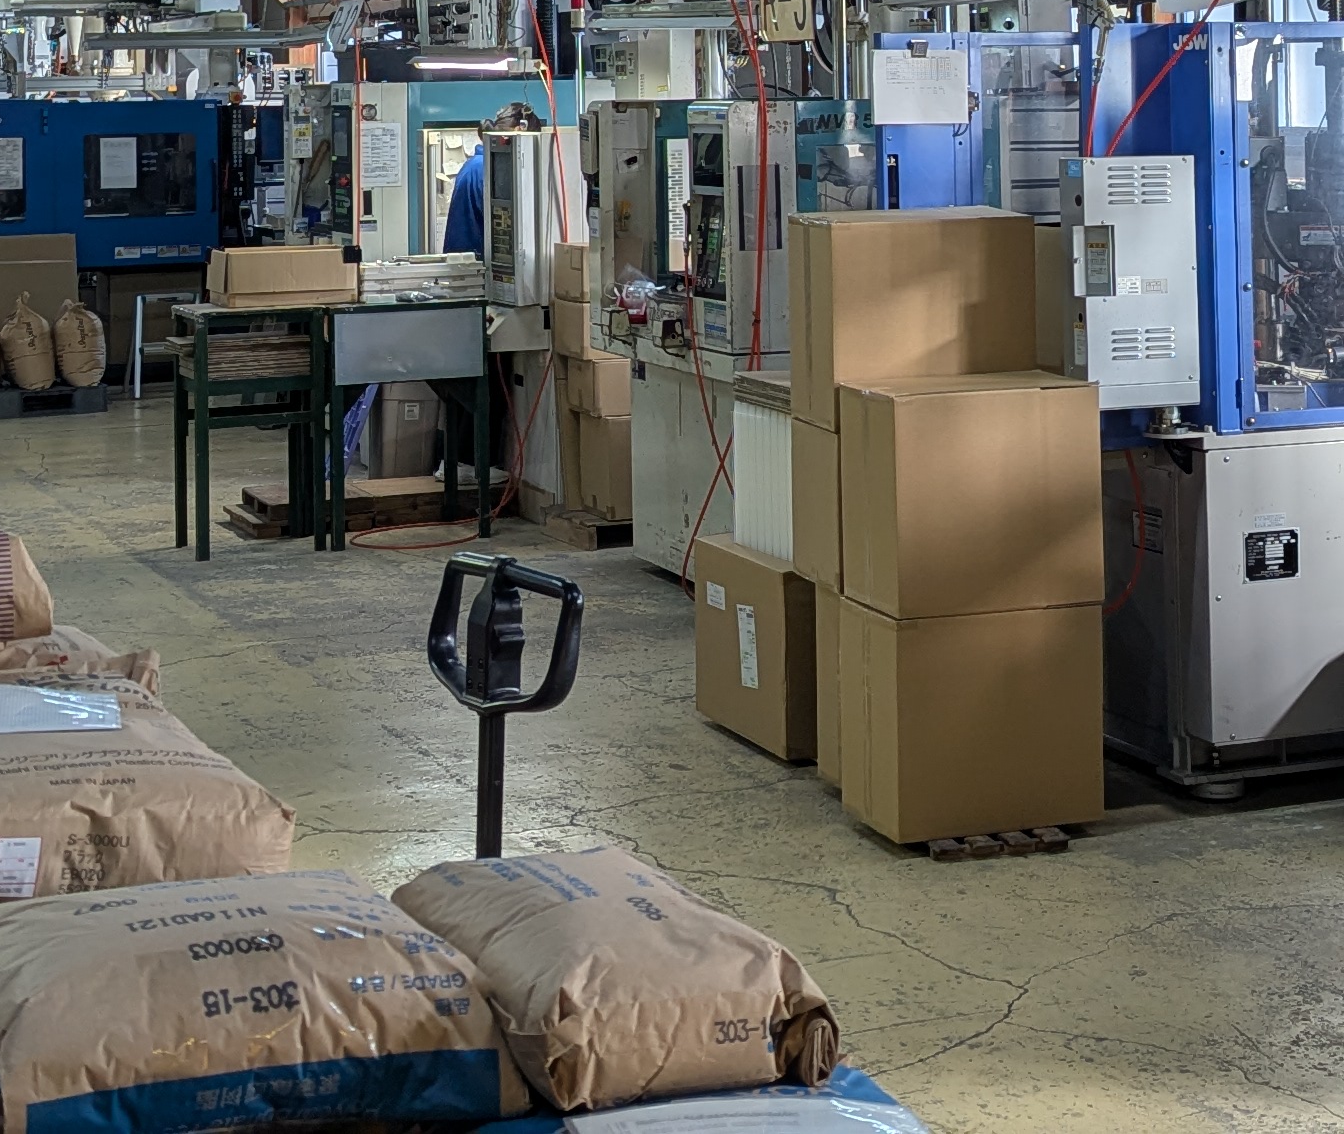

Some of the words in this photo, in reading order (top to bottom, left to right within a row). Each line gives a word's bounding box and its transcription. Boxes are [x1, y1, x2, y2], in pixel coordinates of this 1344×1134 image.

[67, 832, 130, 849] S-3000U
[401, 972, 467, 993] GRADE
[202, 980, 299, 1018] 303-15
